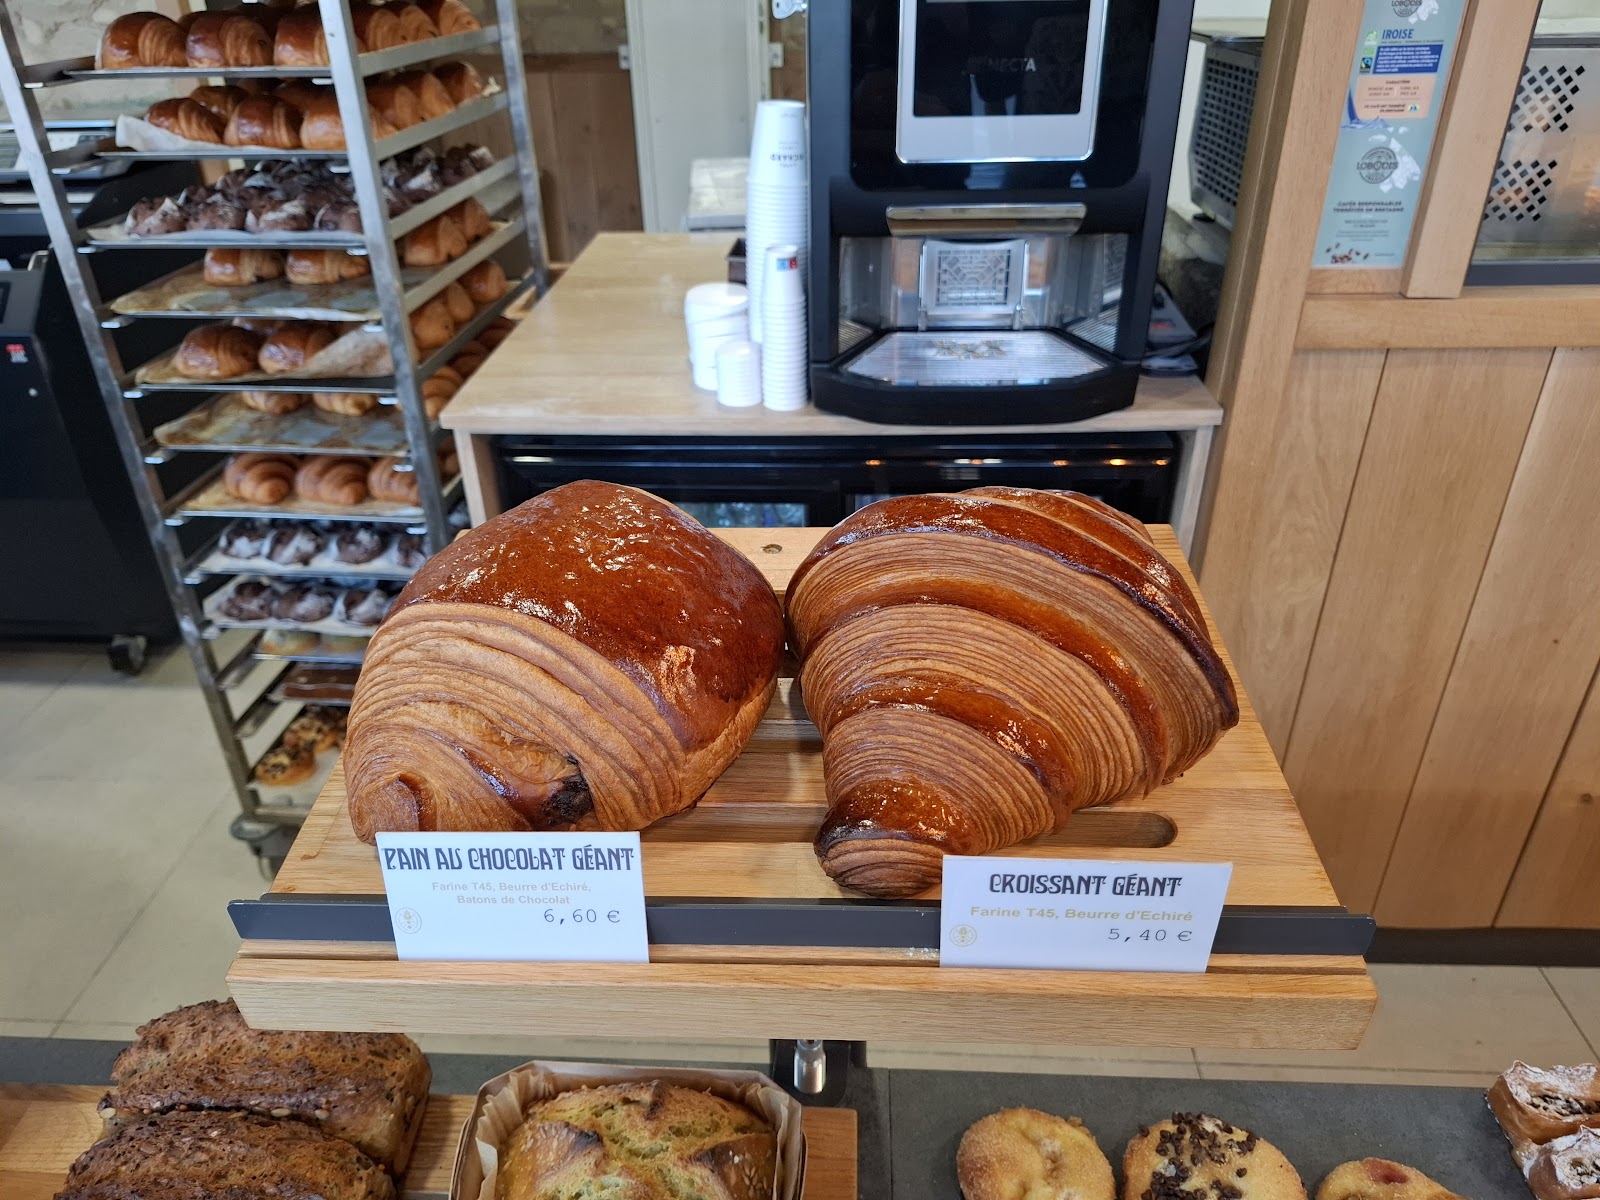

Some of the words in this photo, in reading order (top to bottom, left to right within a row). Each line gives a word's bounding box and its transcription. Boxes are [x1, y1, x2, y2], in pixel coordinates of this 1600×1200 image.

[1382, 29, 1414, 39] IROISE
[382, 847, 431, 870] PAIN
[435, 847, 464, 870] AU
[468, 847, 566, 870] CHOCOLAT
[572, 844, 635, 871] GÉANT
[432, 882, 468, 892] Farine
[473, 882, 496, 893] T45,
[499, 882, 538, 892] Beurre
[989, 873, 1107, 896] CROISSANT
[1111, 873, 1183, 897] GÉANT
[457, 895, 498, 905] Batons
[501, 895, 515, 905] de
[518, 895, 570, 905] Chocolat
[544, 909, 597, 925] 6,60
[606, 910, 621, 923] €
[970, 906, 1020, 917] Farine
[1026, 908, 1059, 920] T45,
[1065, 909, 1120, 920] Beurre
[1125, 909, 1193, 922] d'Echiré
[1108, 928, 1167, 943] 5,40
[1177, 930, 1193, 942] €
